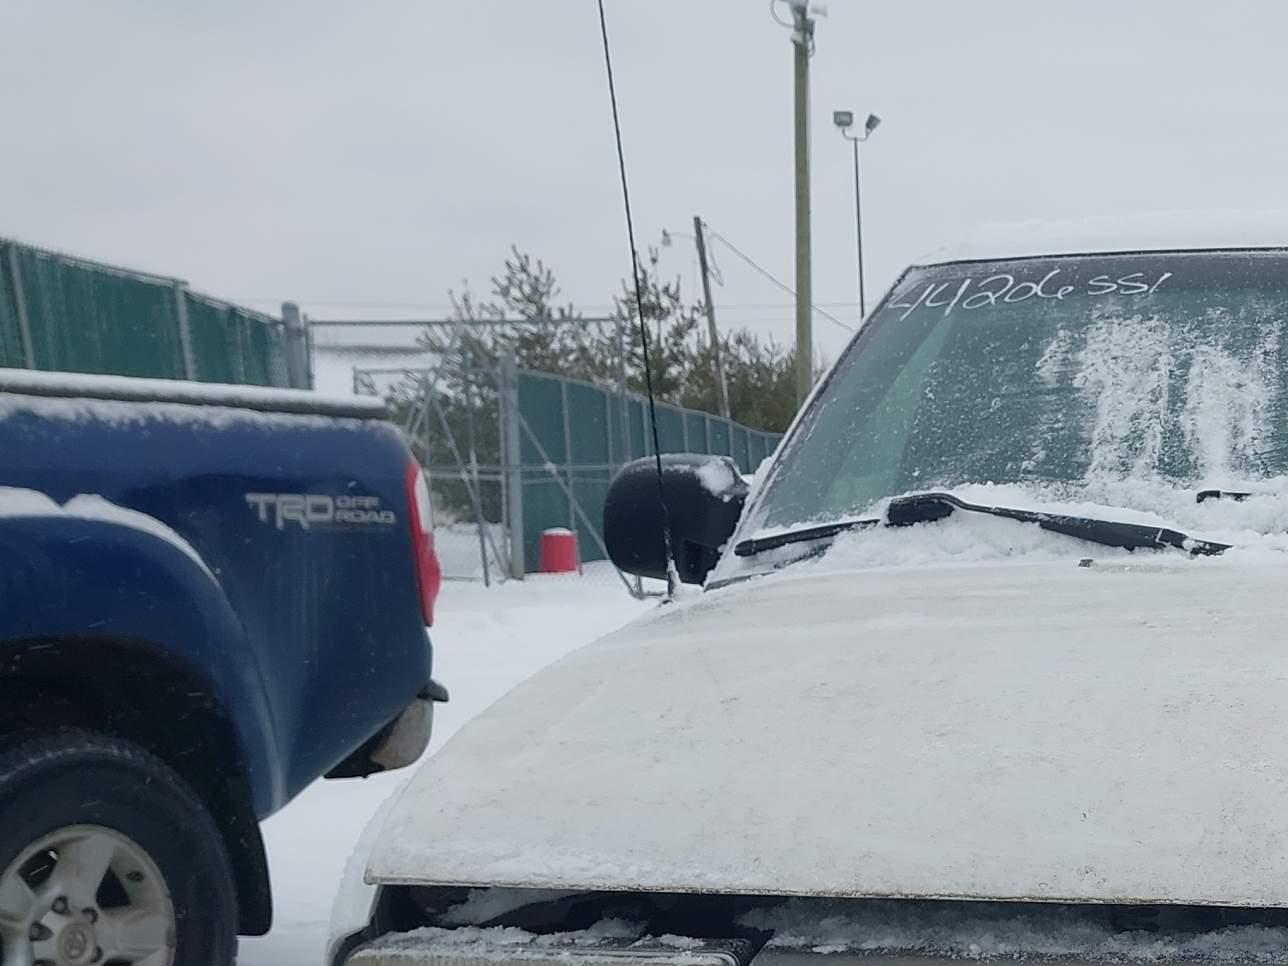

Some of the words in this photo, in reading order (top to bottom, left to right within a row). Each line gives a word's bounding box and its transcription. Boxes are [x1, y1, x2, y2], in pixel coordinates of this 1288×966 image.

[336, 496, 380, 508] OFF
[245, 492, 334, 530] TRD
[336, 509, 396, 524] ROAD
